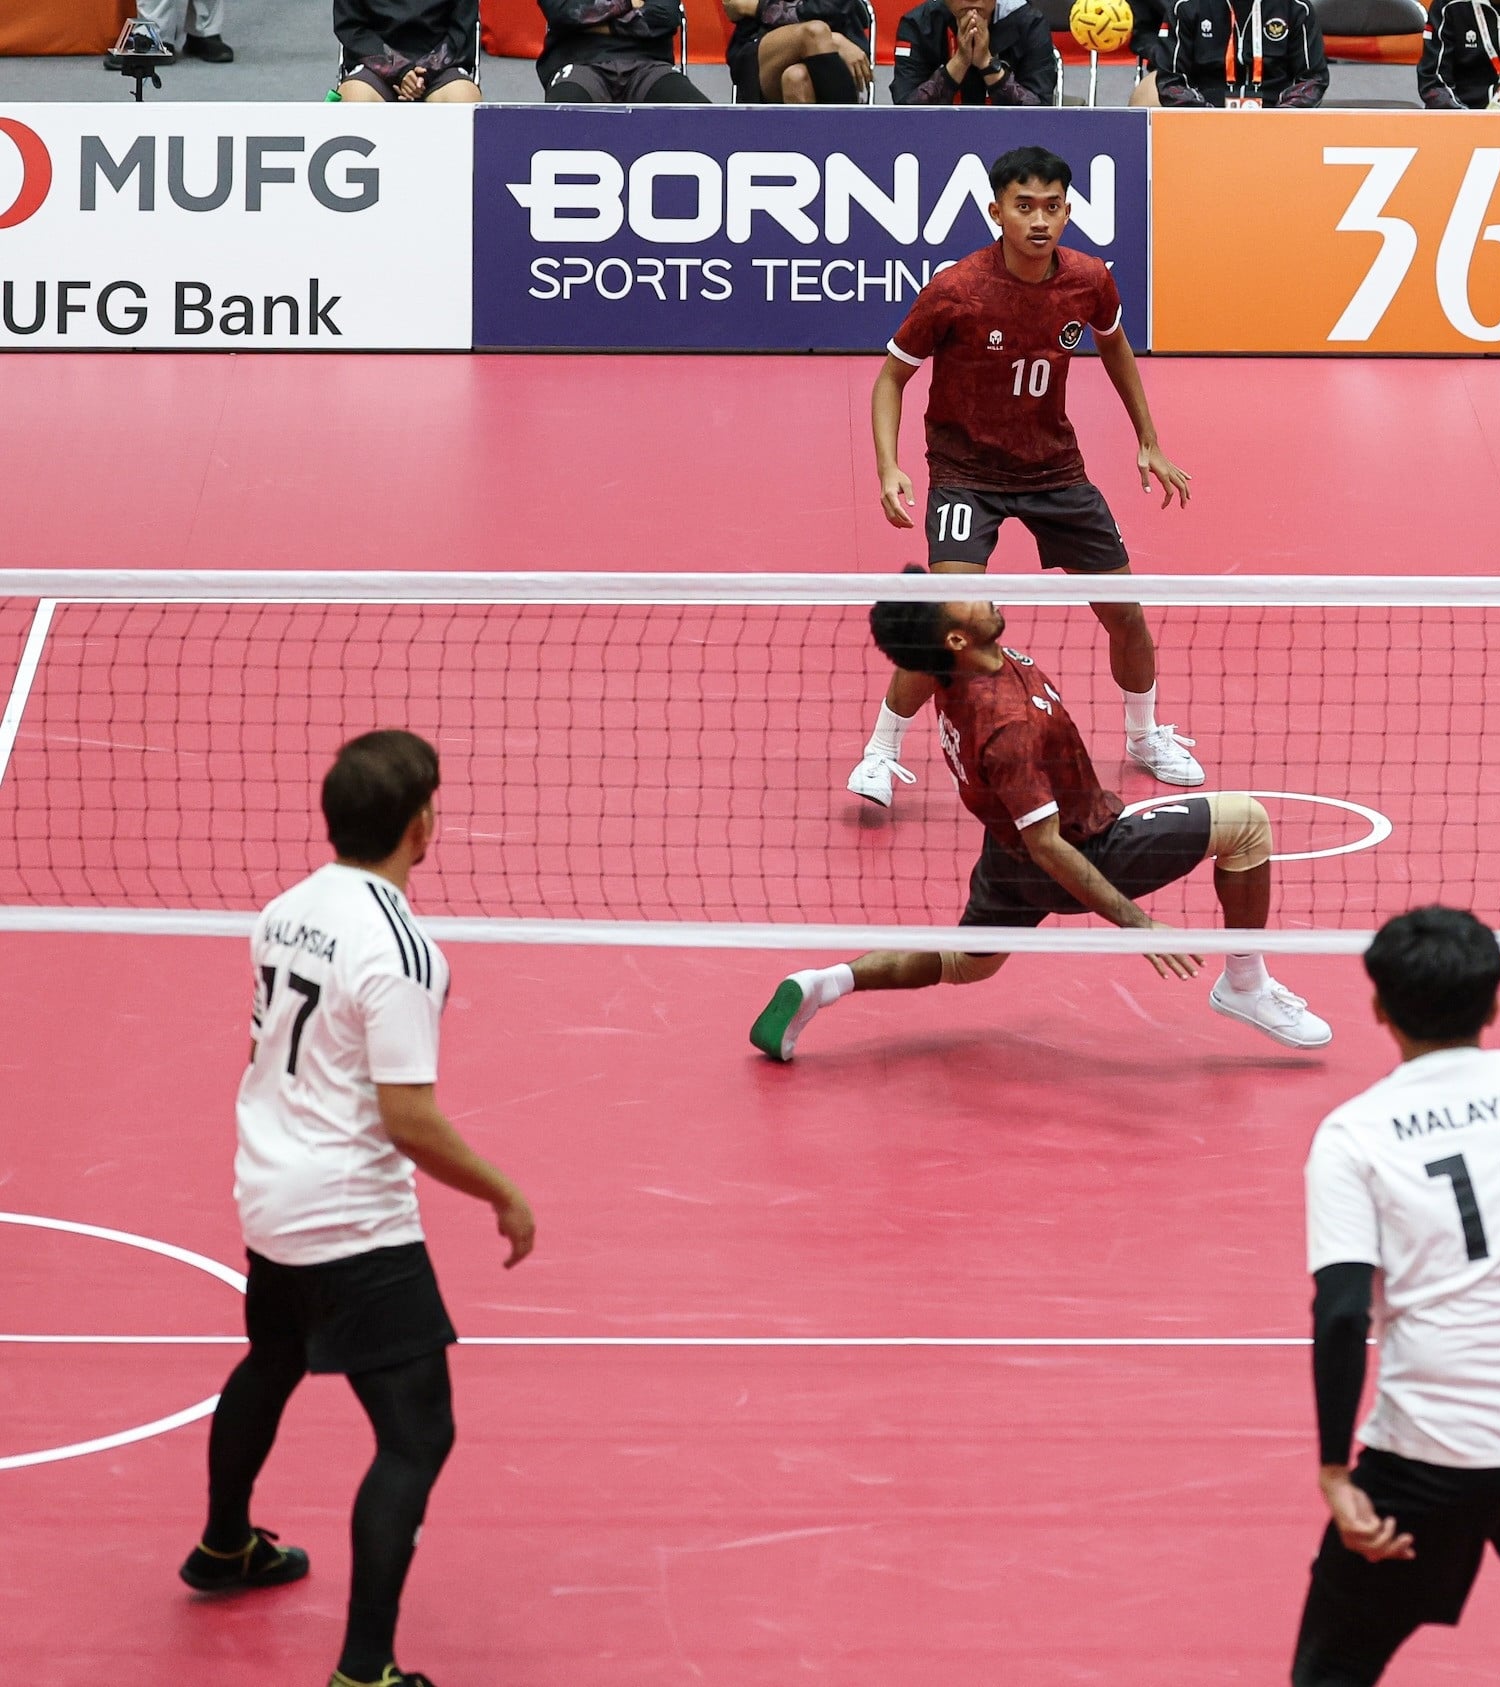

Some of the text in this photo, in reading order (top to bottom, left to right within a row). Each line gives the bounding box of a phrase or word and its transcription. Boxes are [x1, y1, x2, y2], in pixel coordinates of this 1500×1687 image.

[79, 135, 380, 213] MUFG
[528, 257, 733, 301] SPORTS
[174, 277, 343, 336] Bank
[1011, 358, 1051, 397] 10
[936, 503, 973, 542] 10
